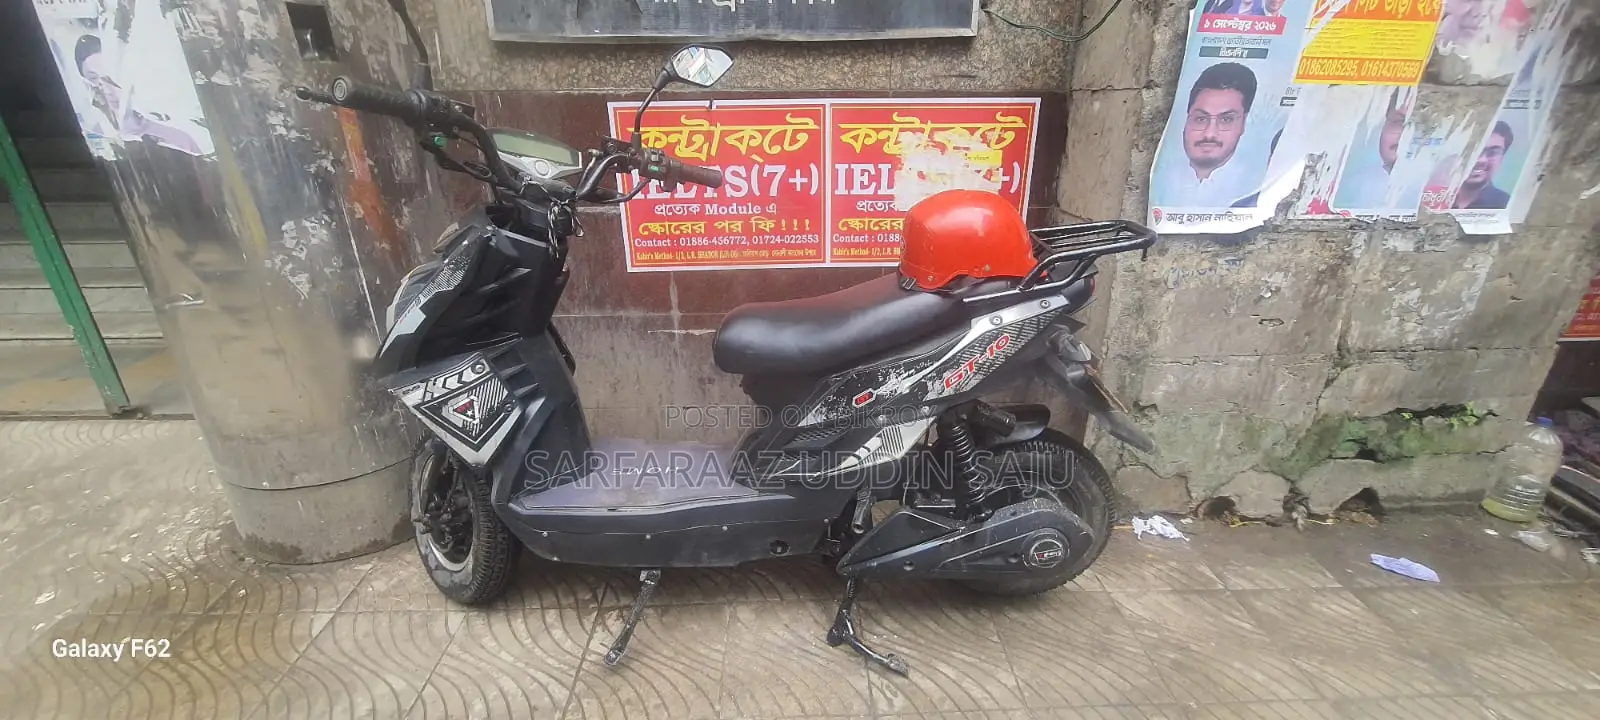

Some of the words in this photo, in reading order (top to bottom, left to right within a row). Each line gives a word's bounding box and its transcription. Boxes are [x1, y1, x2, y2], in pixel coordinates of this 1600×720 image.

[654, 203, 702, 216] প্রত্যেক
[704, 202, 762, 215] Module
[765, 203, 777, 215] এ
[1166, 213, 1184, 224] আবু
[1186, 213, 1212, 222] হাসান
[638, 220, 706, 236] স্কোরের
[714, 219, 744, 233] পর
[749, 216, 777, 232] ফি
[635, 237, 671, 247] Contact
[679, 234, 750, 247] 01886-456772,
[752, 234, 819, 244] 01724-022553
[833, 234, 868, 243] Contact
[944, 334, 1011, 390] GT-10
